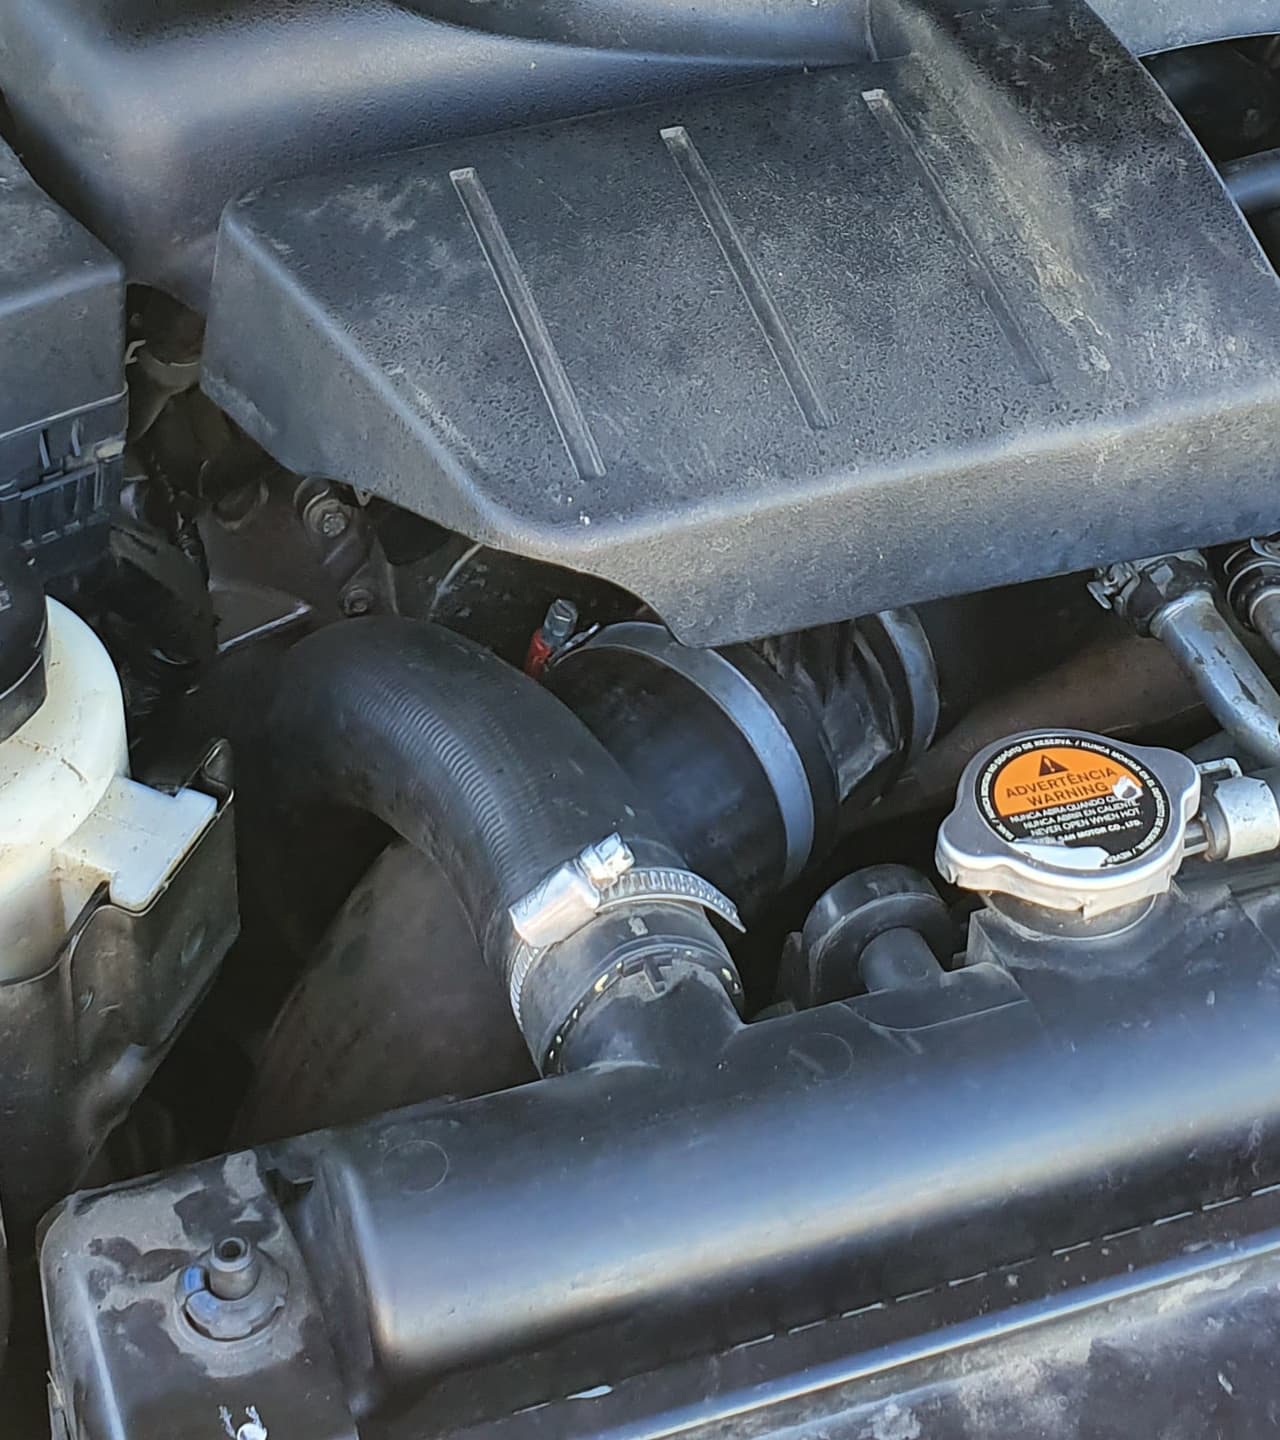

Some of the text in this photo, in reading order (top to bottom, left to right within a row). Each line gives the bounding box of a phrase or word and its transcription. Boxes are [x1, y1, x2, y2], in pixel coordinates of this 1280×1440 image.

[1006, 766, 1118, 799] ADVERTÊNCIA
[1027, 781, 1109, 807] WARNING
[1009, 810, 1043, 824] NUNCA
[1042, 804, 1067, 817] ABRA
[1066, 796, 1106, 811] QUANDO
[1023, 816, 1057, 830] NUNCA
[1056, 810, 1084, 823] ABRIR
[1083, 808, 1097, 818] EN
[1031, 823, 1063, 837] NEVER
[1062, 818, 1090, 831] OPEN
[1089, 811, 1120, 825] WHEN
[1076, 826, 1108, 839] MOTOR
